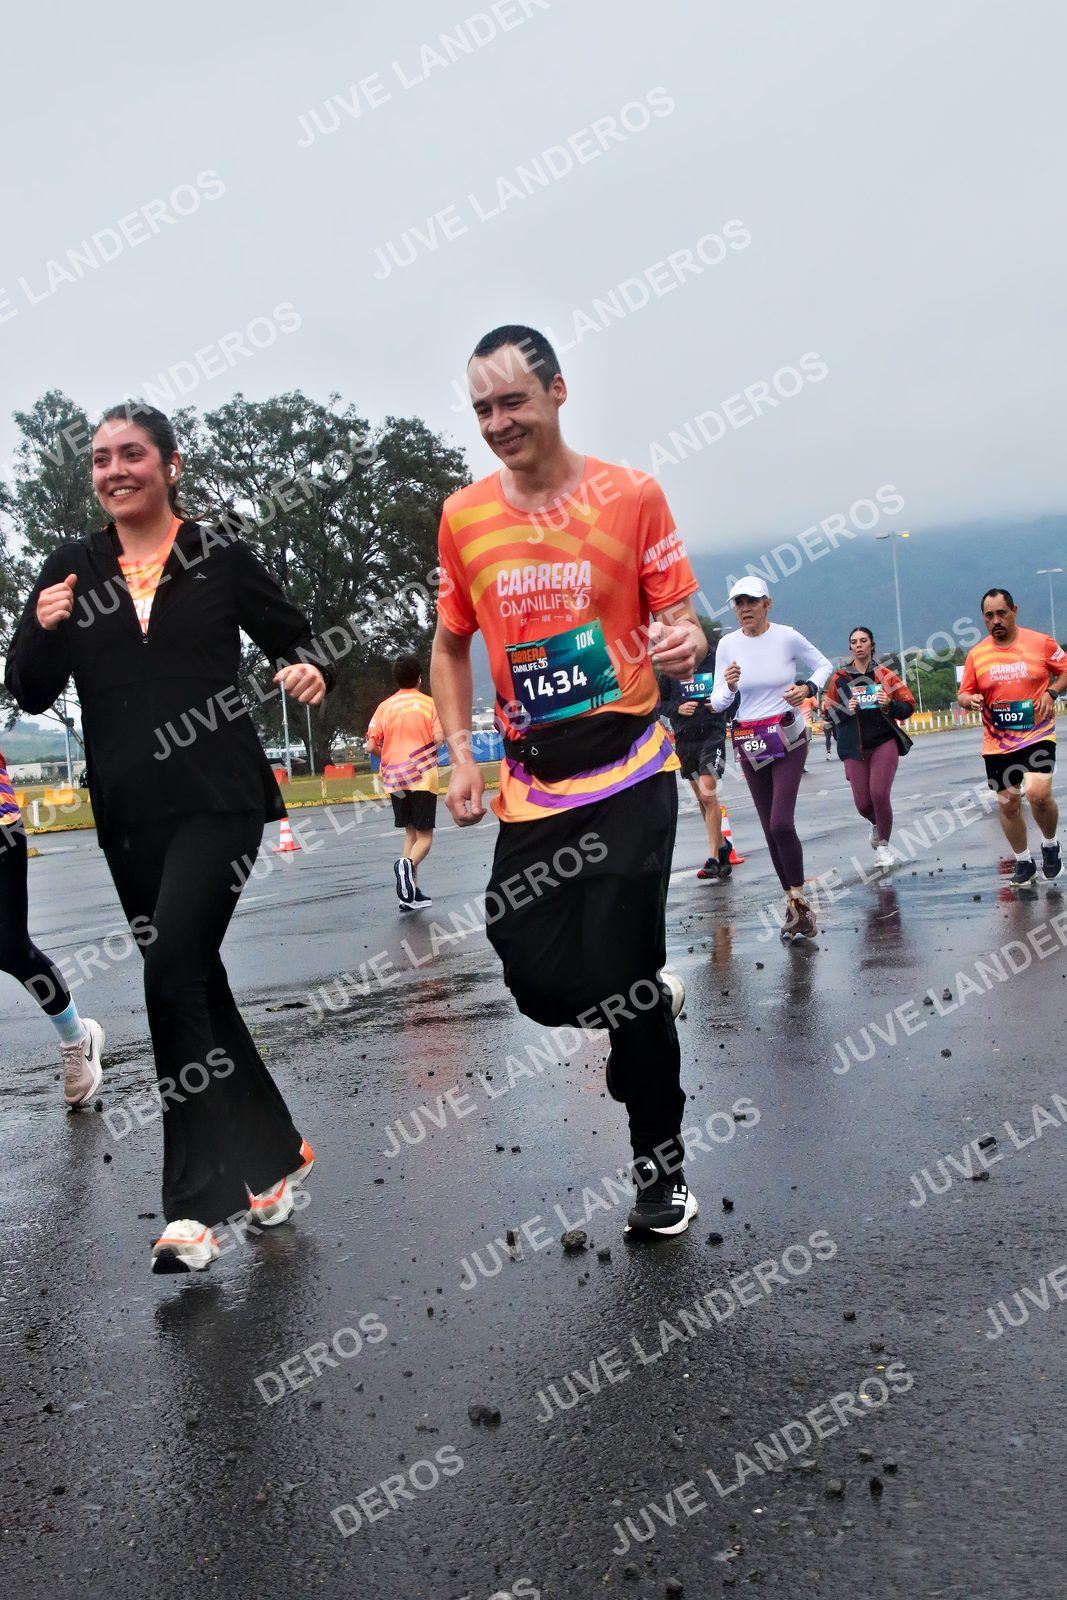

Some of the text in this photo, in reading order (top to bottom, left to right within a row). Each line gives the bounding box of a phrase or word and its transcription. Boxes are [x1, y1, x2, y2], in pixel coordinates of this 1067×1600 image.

[497, 560, 592, 597] CARRERA
[500, 593, 570, 617] OMNILIFE
[575, 629, 595, 651] 10K
[523, 665, 587, 700] 1434
[685, 683, 705, 693] 1610
[856, 694, 877, 703] 1609
[999, 712, 1024, 722] 1097
[744, 739, 767, 751] 694
